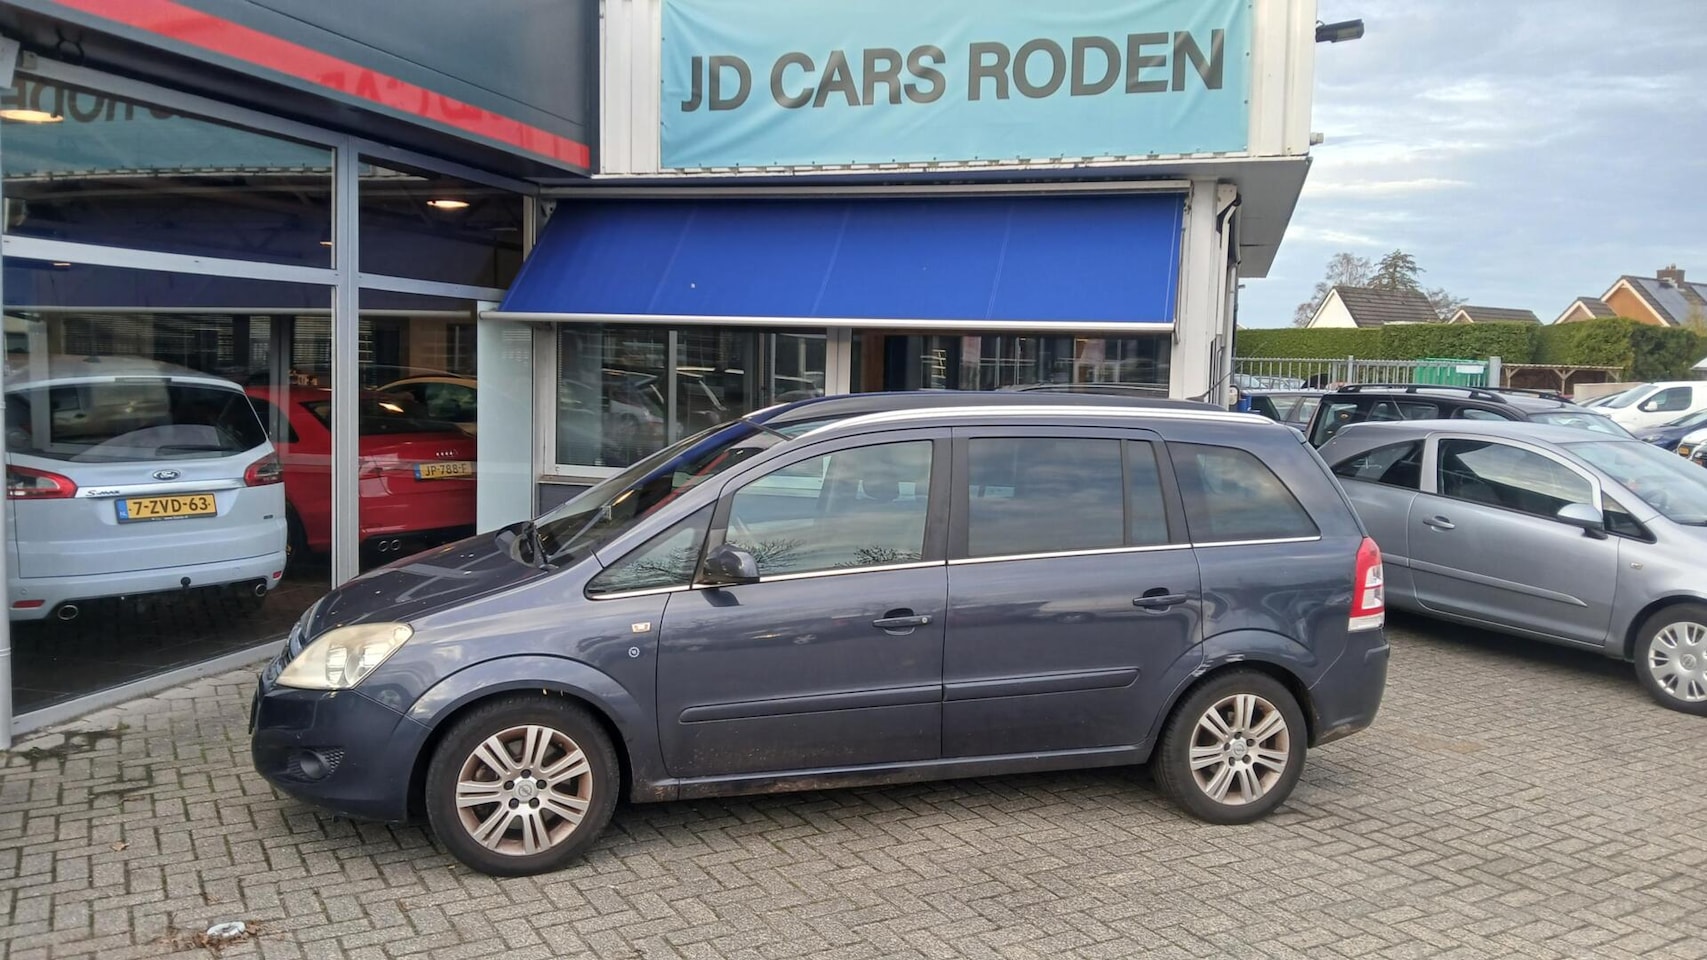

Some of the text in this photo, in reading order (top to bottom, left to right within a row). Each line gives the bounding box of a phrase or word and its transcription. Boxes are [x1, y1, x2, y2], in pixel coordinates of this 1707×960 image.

[681, 29, 1224, 112] JD CARS RODEN
[132, 497, 208, 515] 7-ZVD-63
